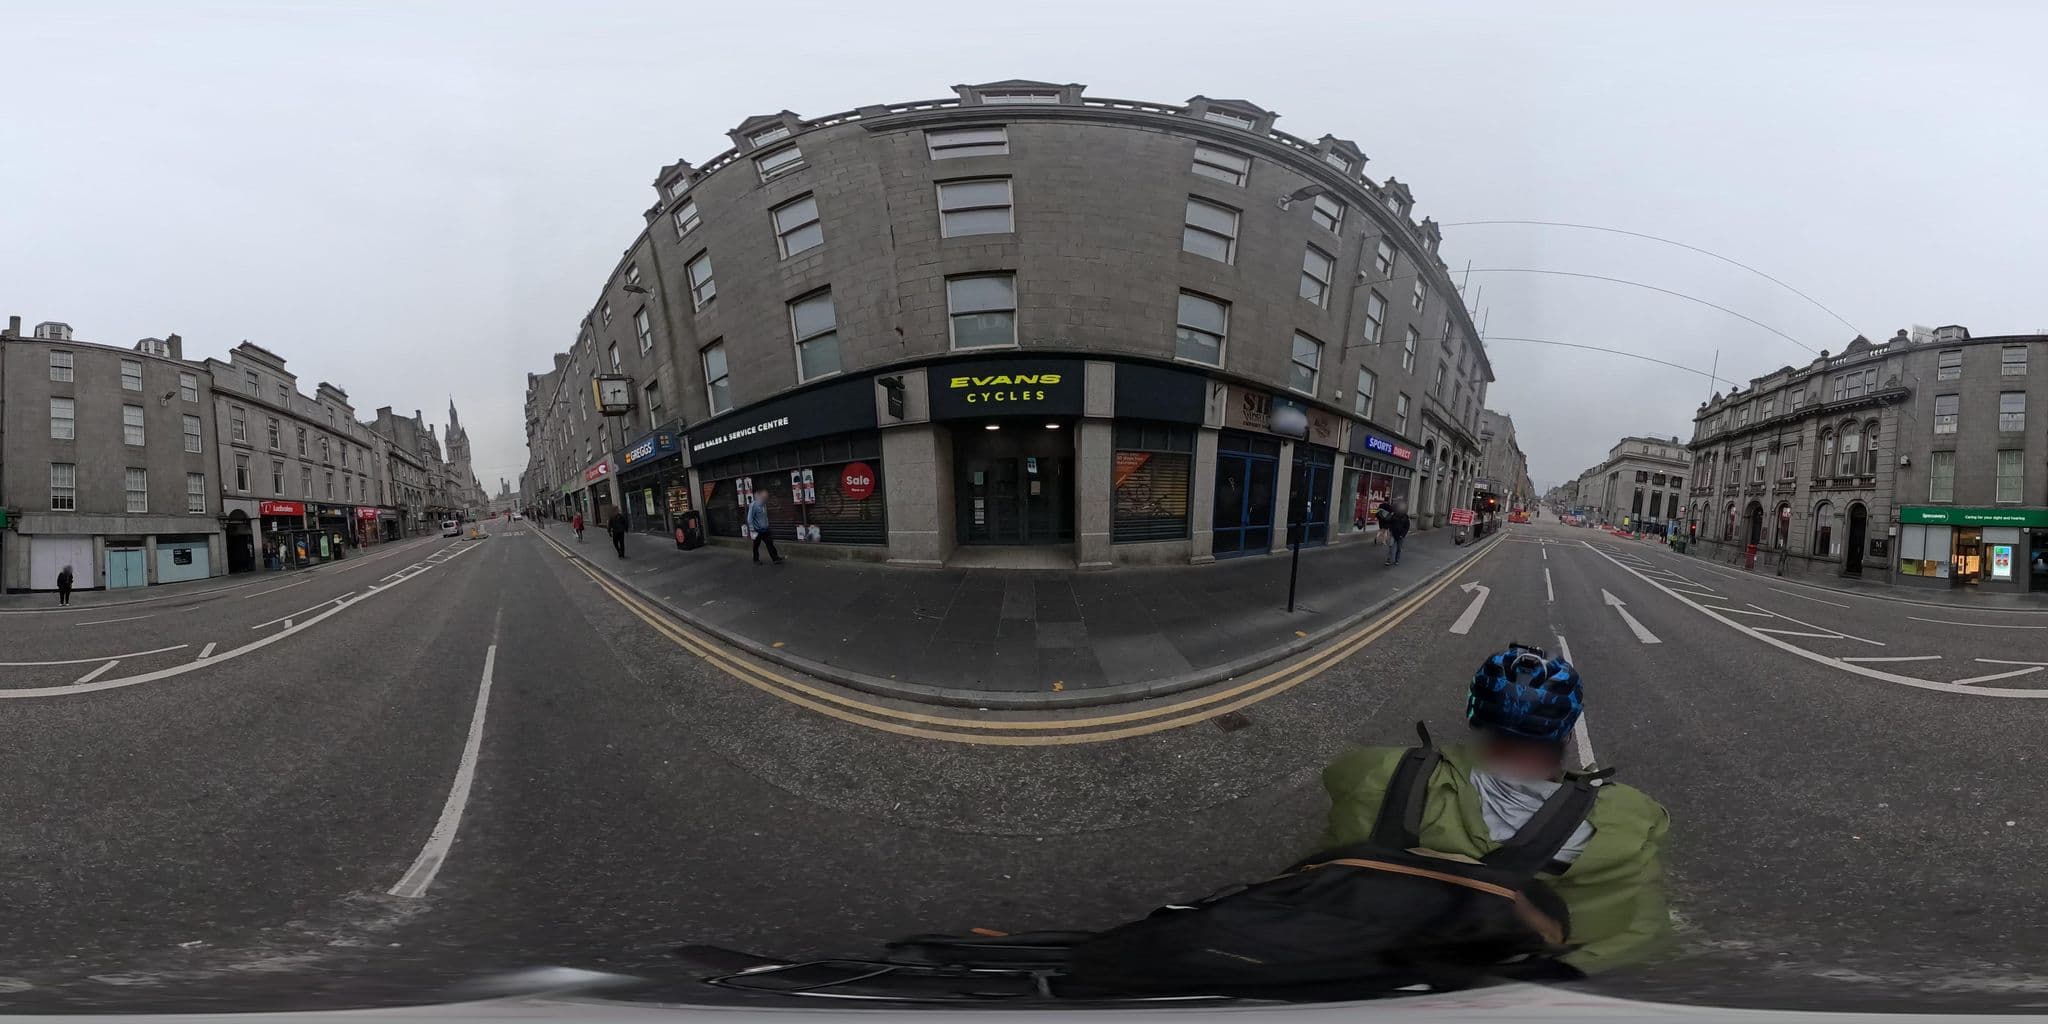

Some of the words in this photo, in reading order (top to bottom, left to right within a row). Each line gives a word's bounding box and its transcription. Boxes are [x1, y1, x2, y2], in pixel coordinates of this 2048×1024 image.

[950, 375, 1061, 388] EVANS
[967, 391, 1045, 403] CYCLES
[693, 443, 705, 452] BIKE
[706, 436, 722, 448] SALES
[728, 426, 757, 441] SERVICE
[757, 417, 789, 432] CENTRE
[630, 442, 652, 461] GREGGS
[1369, 437, 1392, 453] SPORTS
[1393, 446, 1411, 460] DIRECT
[846, 475, 870, 485] Sale
